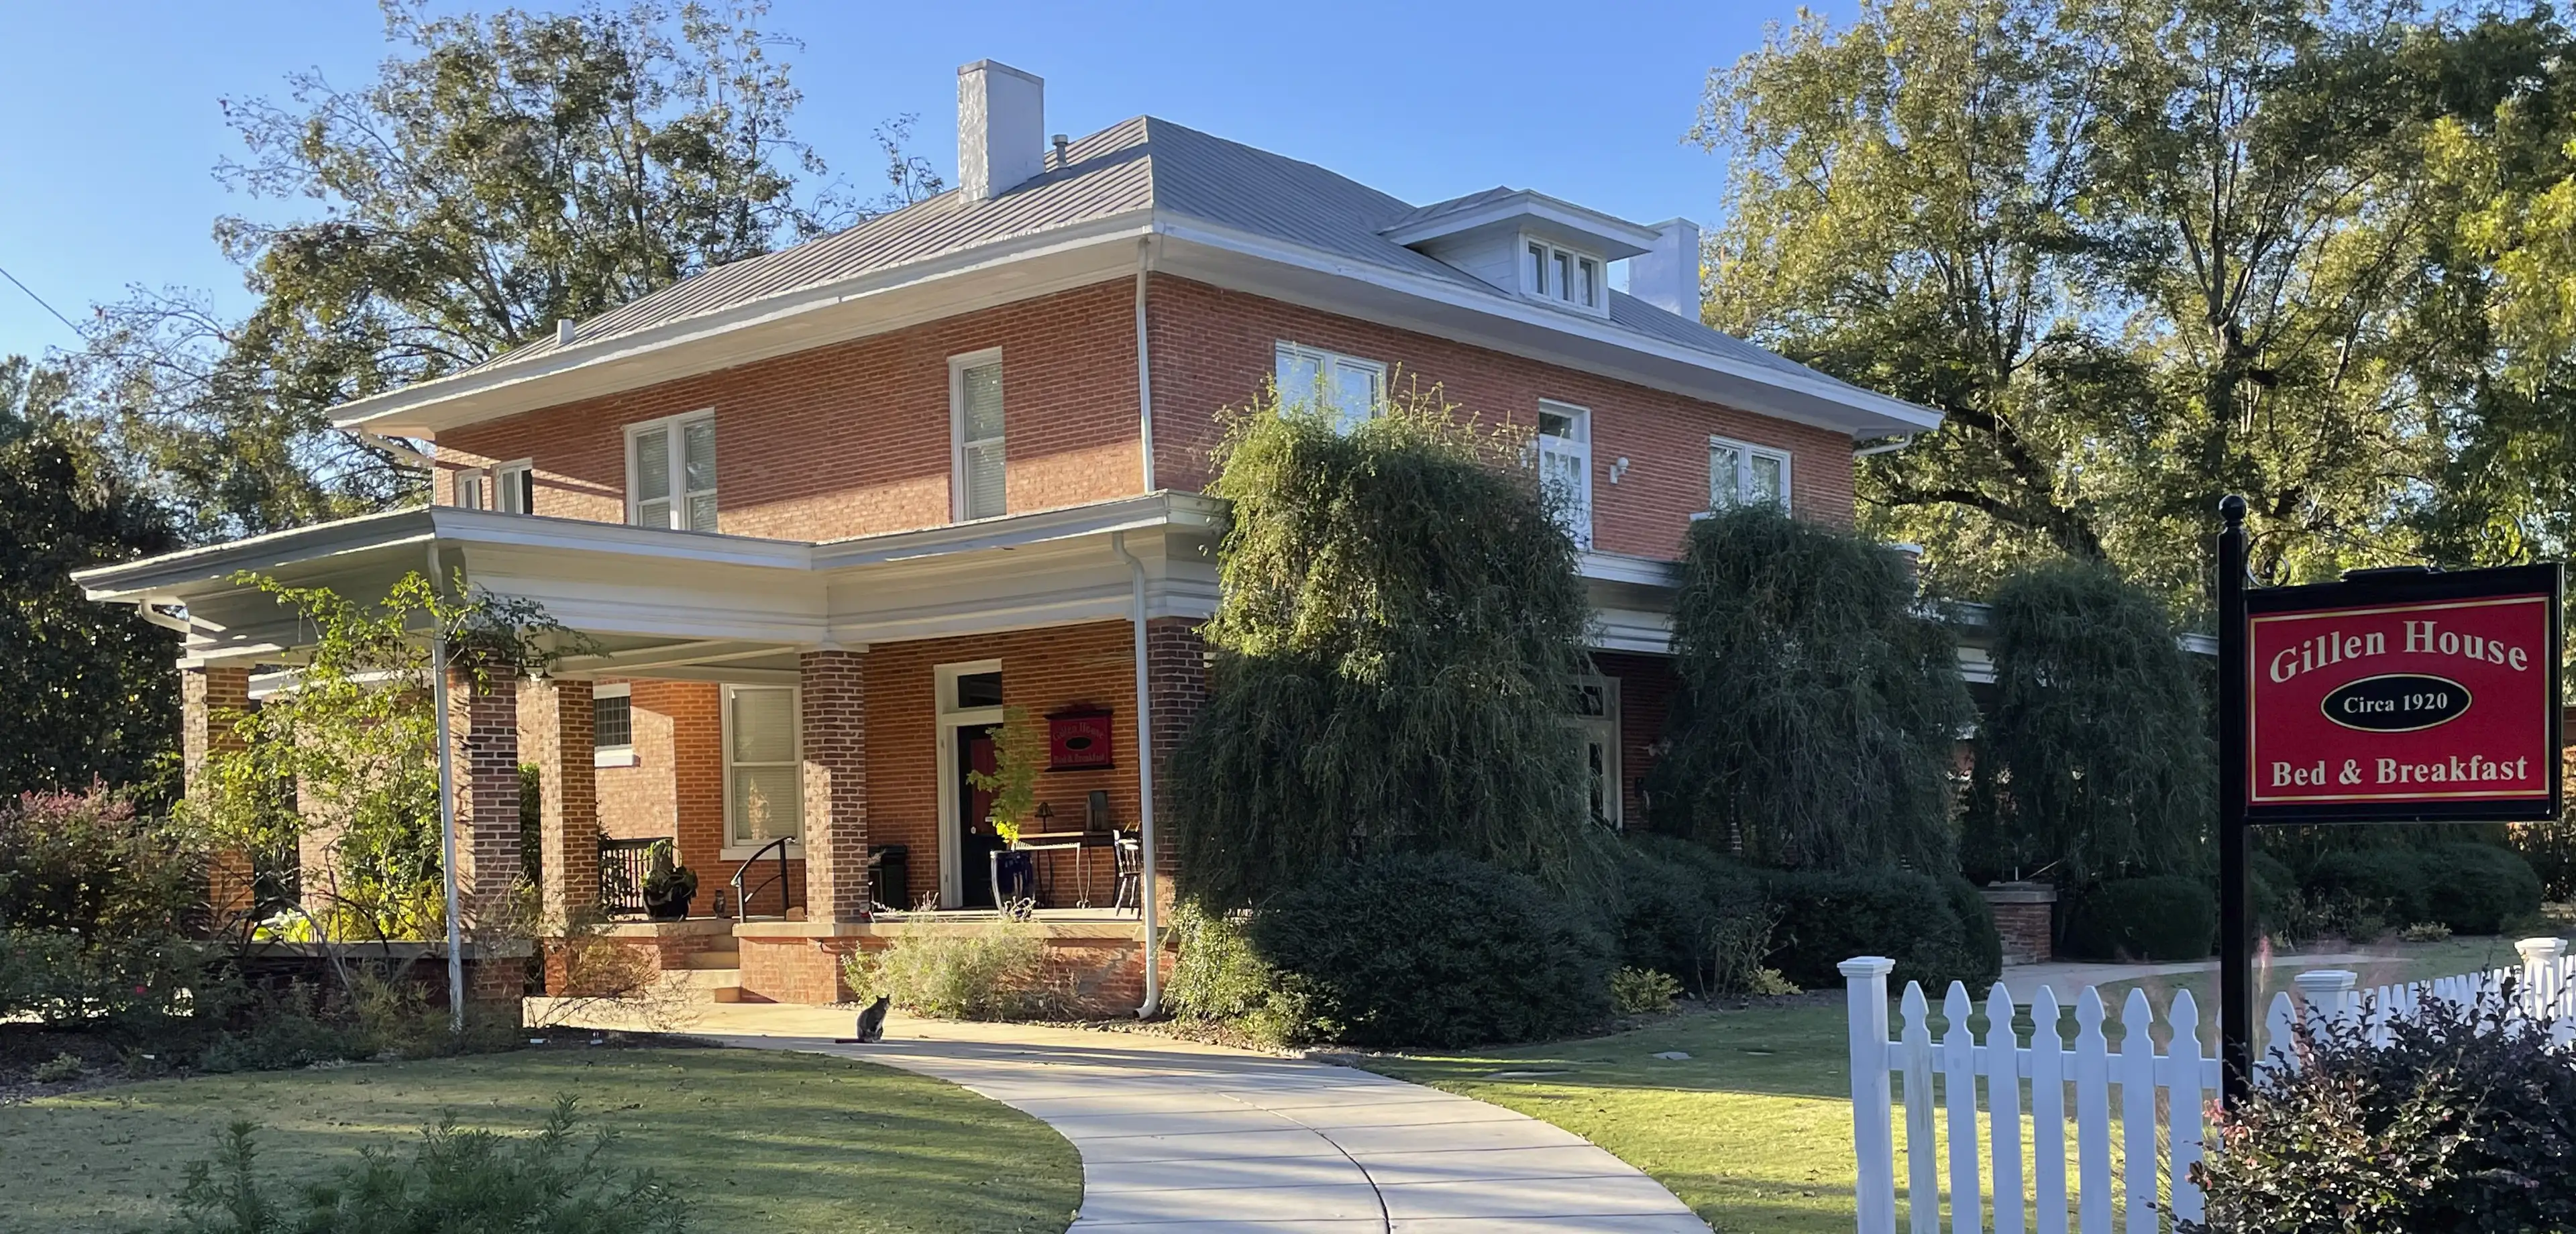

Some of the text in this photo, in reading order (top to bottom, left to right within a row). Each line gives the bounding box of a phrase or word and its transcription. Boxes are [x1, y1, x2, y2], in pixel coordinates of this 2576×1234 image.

[2269, 620, 2528, 683] Gillen House
[2344, 692, 2448, 713] Circa 1920
[2271, 754, 2528, 787] Bed & Breakfast
